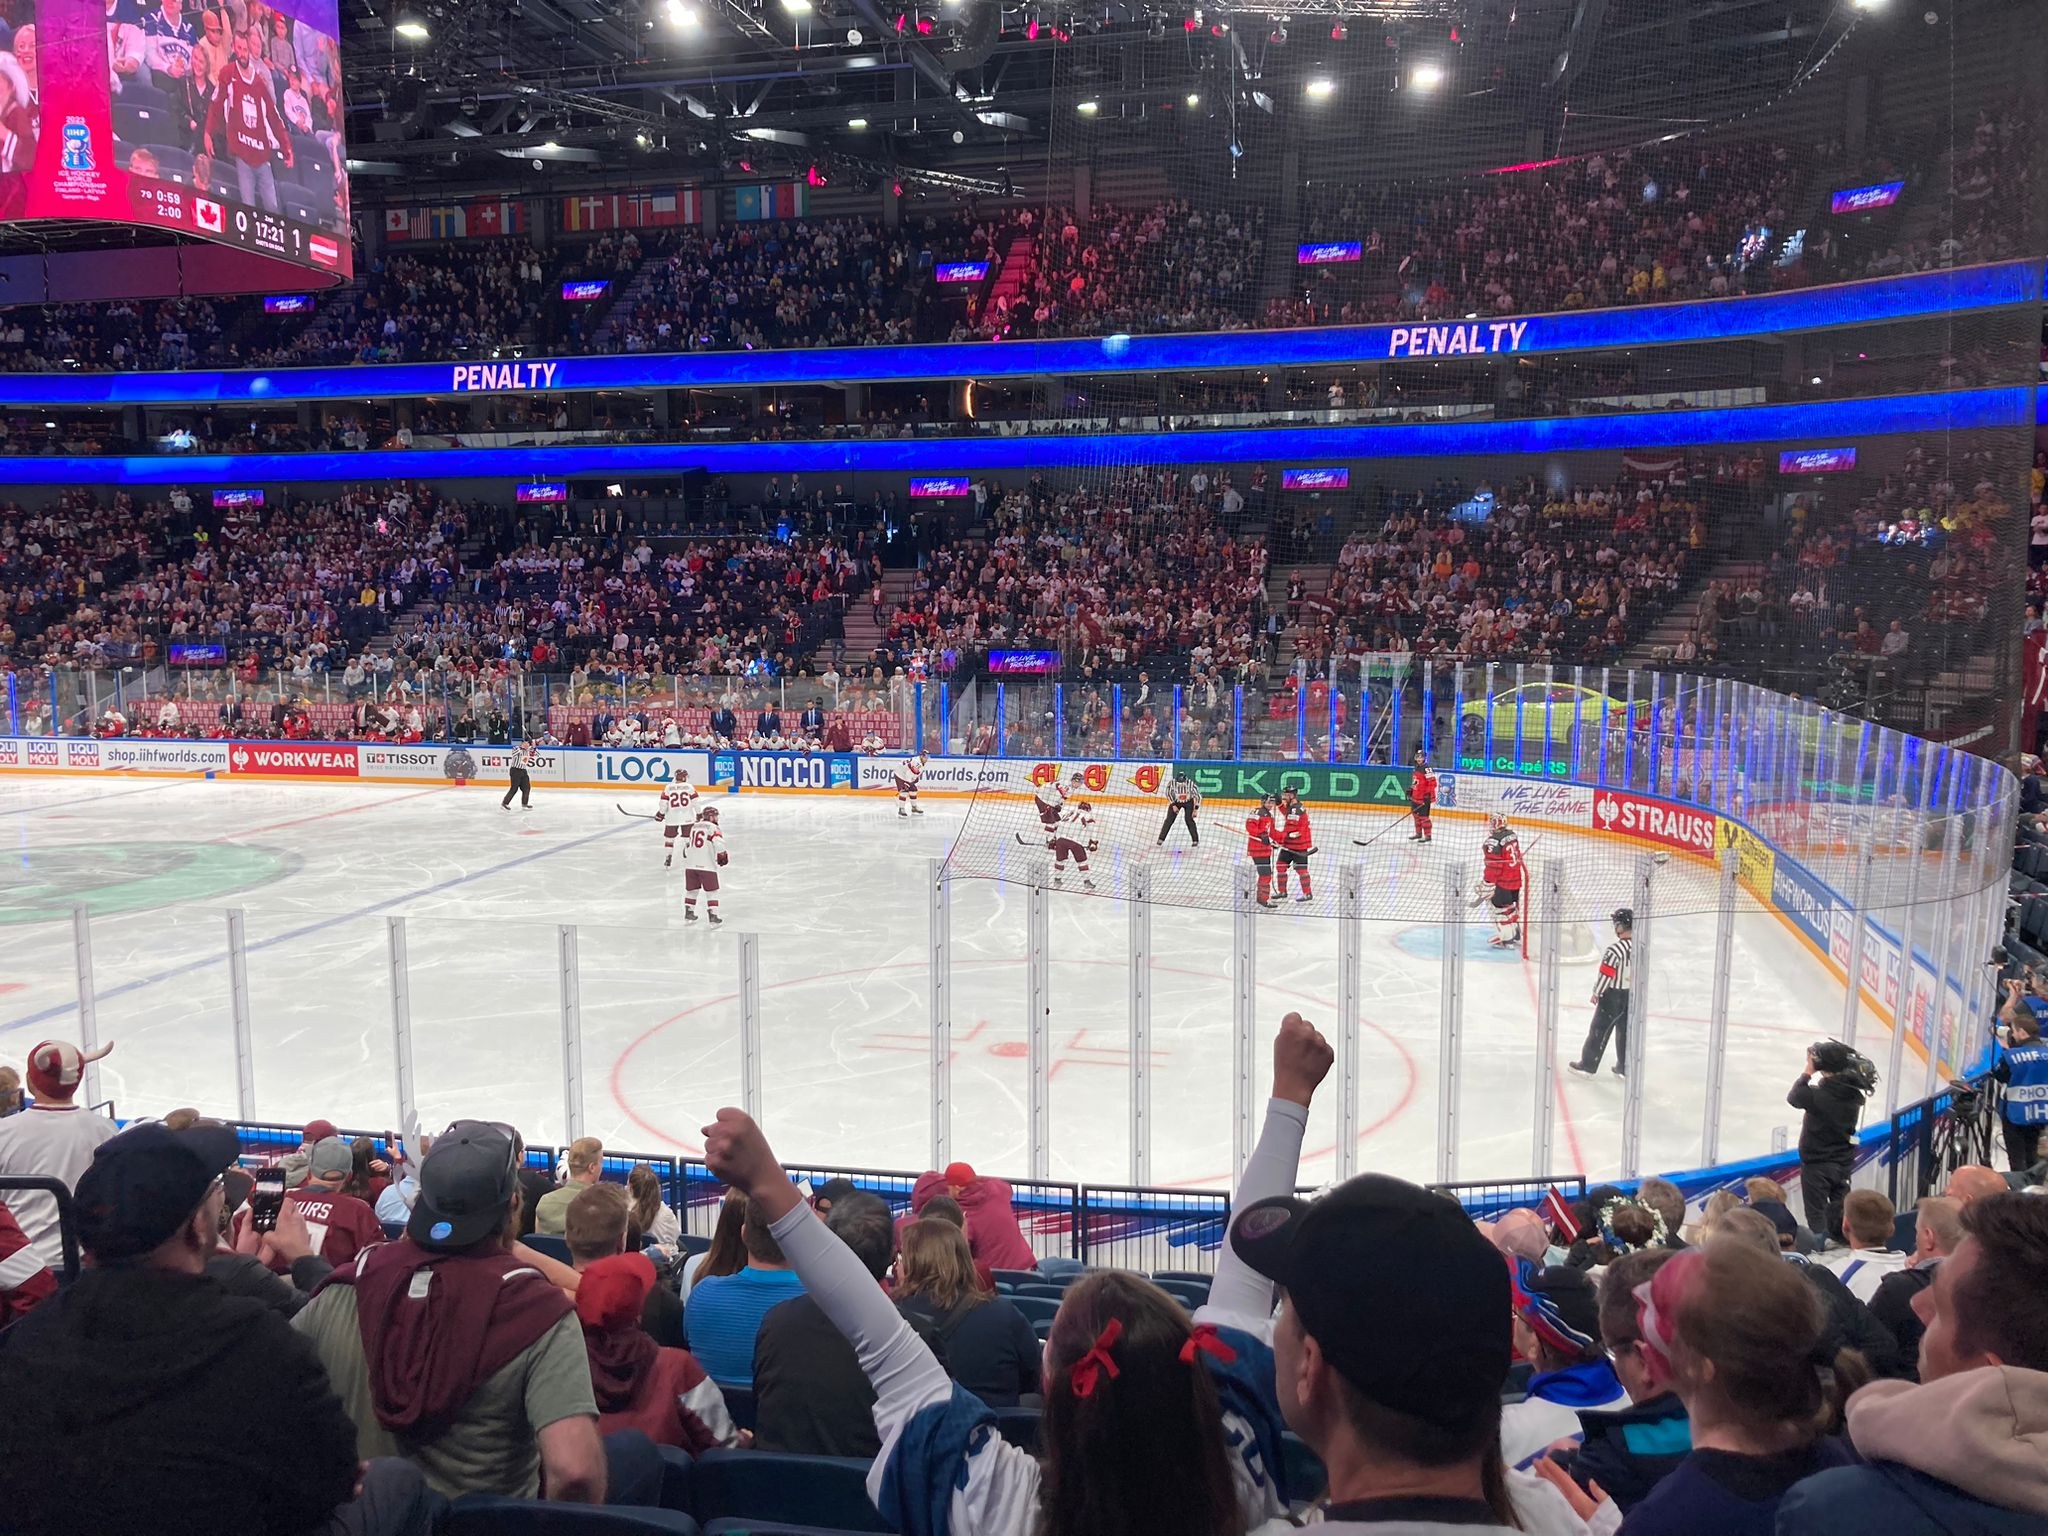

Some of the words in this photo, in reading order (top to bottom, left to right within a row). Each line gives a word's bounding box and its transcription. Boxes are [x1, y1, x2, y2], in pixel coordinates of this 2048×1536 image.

[66, 128, 86, 137] IIHF
[156, 190, 180, 204] 0:59
[157, 204, 182, 219] 2:00
[235, 211, 248, 232] 0
[255, 221, 284, 244] 17:21
[292, 229, 300, 248] 1
[1388, 321, 1528, 357] PENALTY
[452, 362, 557, 391] PENALTY
[0, 742, 18, 754] QUI
[28, 742, 58, 754] LIQUI
[69, 743, 98, 755] LIQUI
[107, 747, 226, 764] shop.iihfworlds.com
[0, 753, 18, 765] OLY
[29, 753, 58, 765] MOLY
[69, 754, 99, 766] MOLY
[253, 751, 356, 769] WORKWEAR
[386, 753, 438, 765] TISSOT
[502, 756, 556, 768] TSOT
[596, 753, 674, 783] iLOQ
[740, 756, 825, 788] NOCCO
[669, 791, 689, 808] 26
[1500, 784, 1532, 800] WE
[1533, 785, 1573, 800] LIVE
[1512, 800, 1543, 815] THE
[1544, 800, 1591, 815] GAME
[1621, 800, 1713, 850] STRAUSS
[691, 830, 706, 848] 16
[294, 1200, 334, 1220] URS
